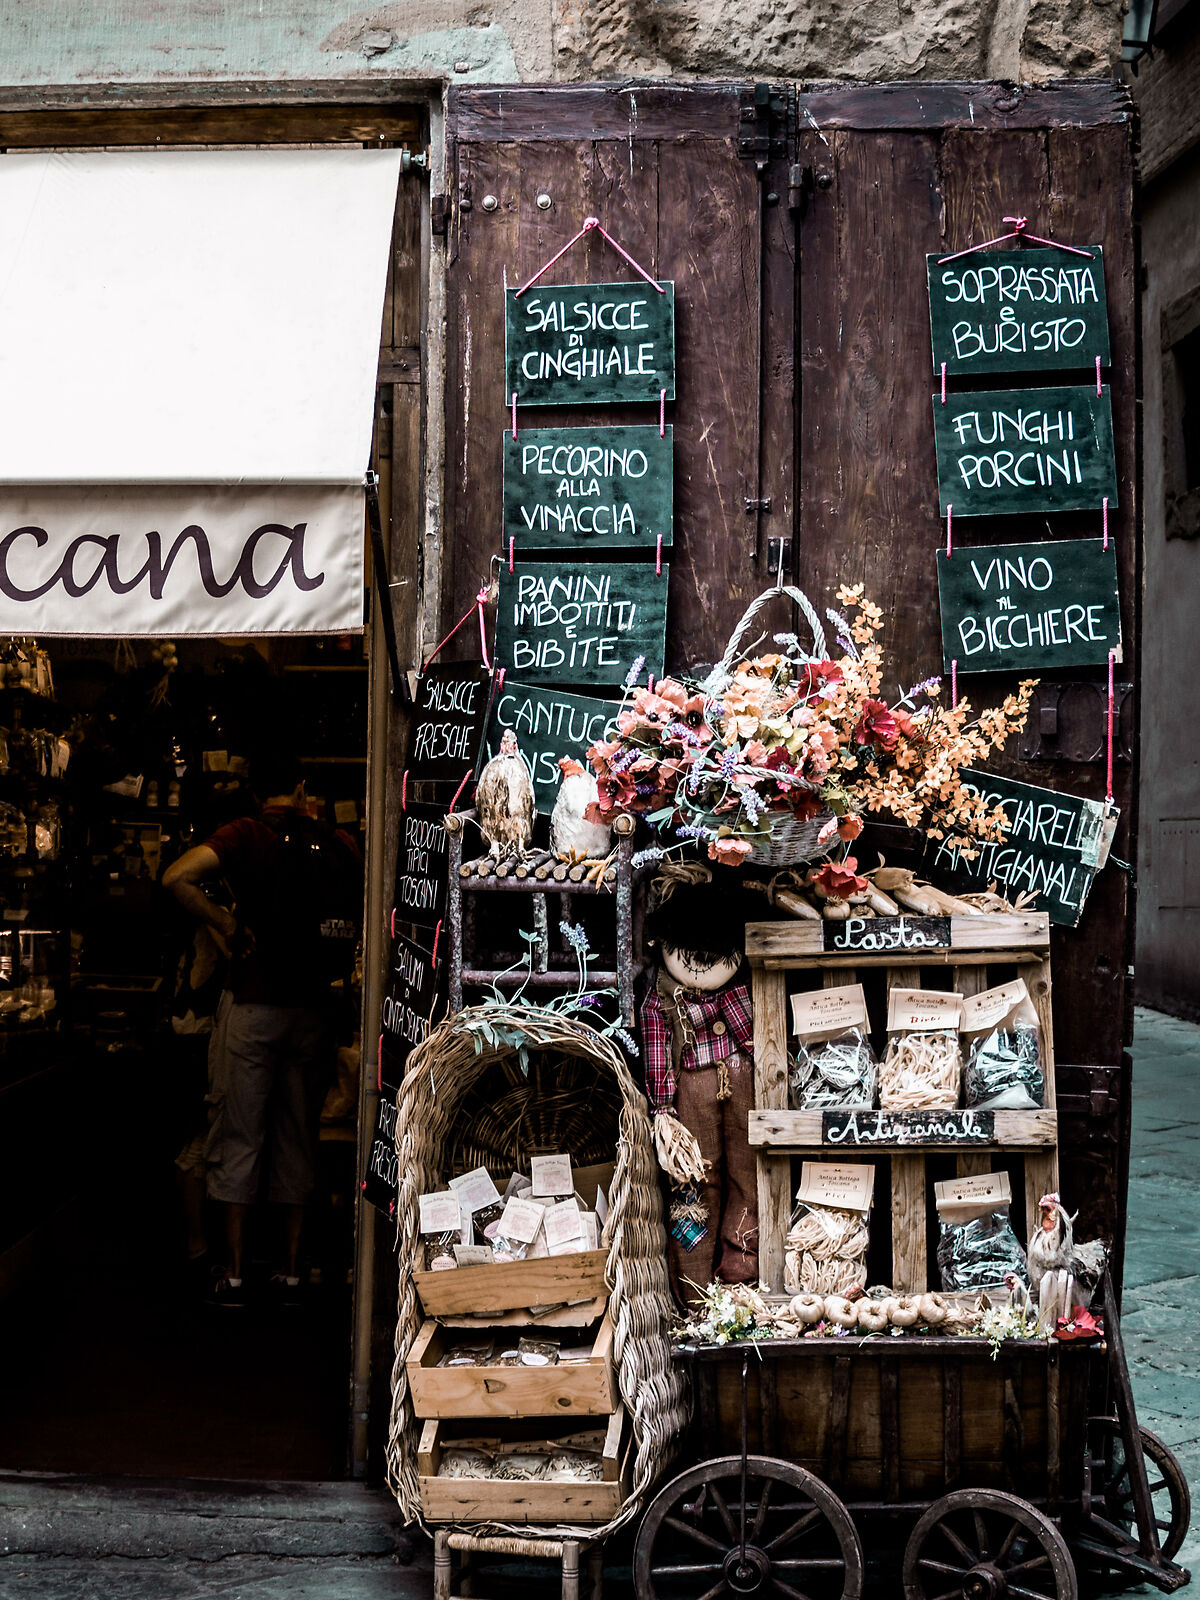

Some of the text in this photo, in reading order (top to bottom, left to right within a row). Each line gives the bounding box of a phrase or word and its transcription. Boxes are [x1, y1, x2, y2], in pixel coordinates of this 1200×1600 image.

[941, 265, 1099, 304] SOPRASSATA
[525, 299, 649, 332] SALSICCE
[999, 306, 1016, 322] e
[568, 334, 584, 347] DI
[952, 317, 1086, 359] BURISTO
[521, 343, 656, 381] CINGHIALE
[953, 408, 1074, 446] FUNGHI
[522, 445, 648, 478] PECORINO
[959, 449, 1083, 490] PORCINI
[556, 478, 601, 498] ALLA
[520, 503, 636, 535] VINACCIA
[518, 575, 611, 602] PANINI
[971, 556, 1053, 592] VINO
[513, 601, 636, 631] IMBOTTITI
[997, 597, 1016, 611] AL
[565, 625, 577, 639] E
[958, 605, 1107, 655] BICCHIERE
[513, 636, 620, 669] BIBITE
[423, 678, 481, 715] SALSICCE
[497, 695, 619, 745] CANTUCC
[414, 722, 475, 761] FRESCHE
[407, 847, 429, 874] TIPICI
[400, 875, 438, 910] TOSCANI
[395, 942, 425, 992] SALUMI
[403, 1007, 430, 1047] SENES
[827, 1110, 988, 1145] Artigianale
